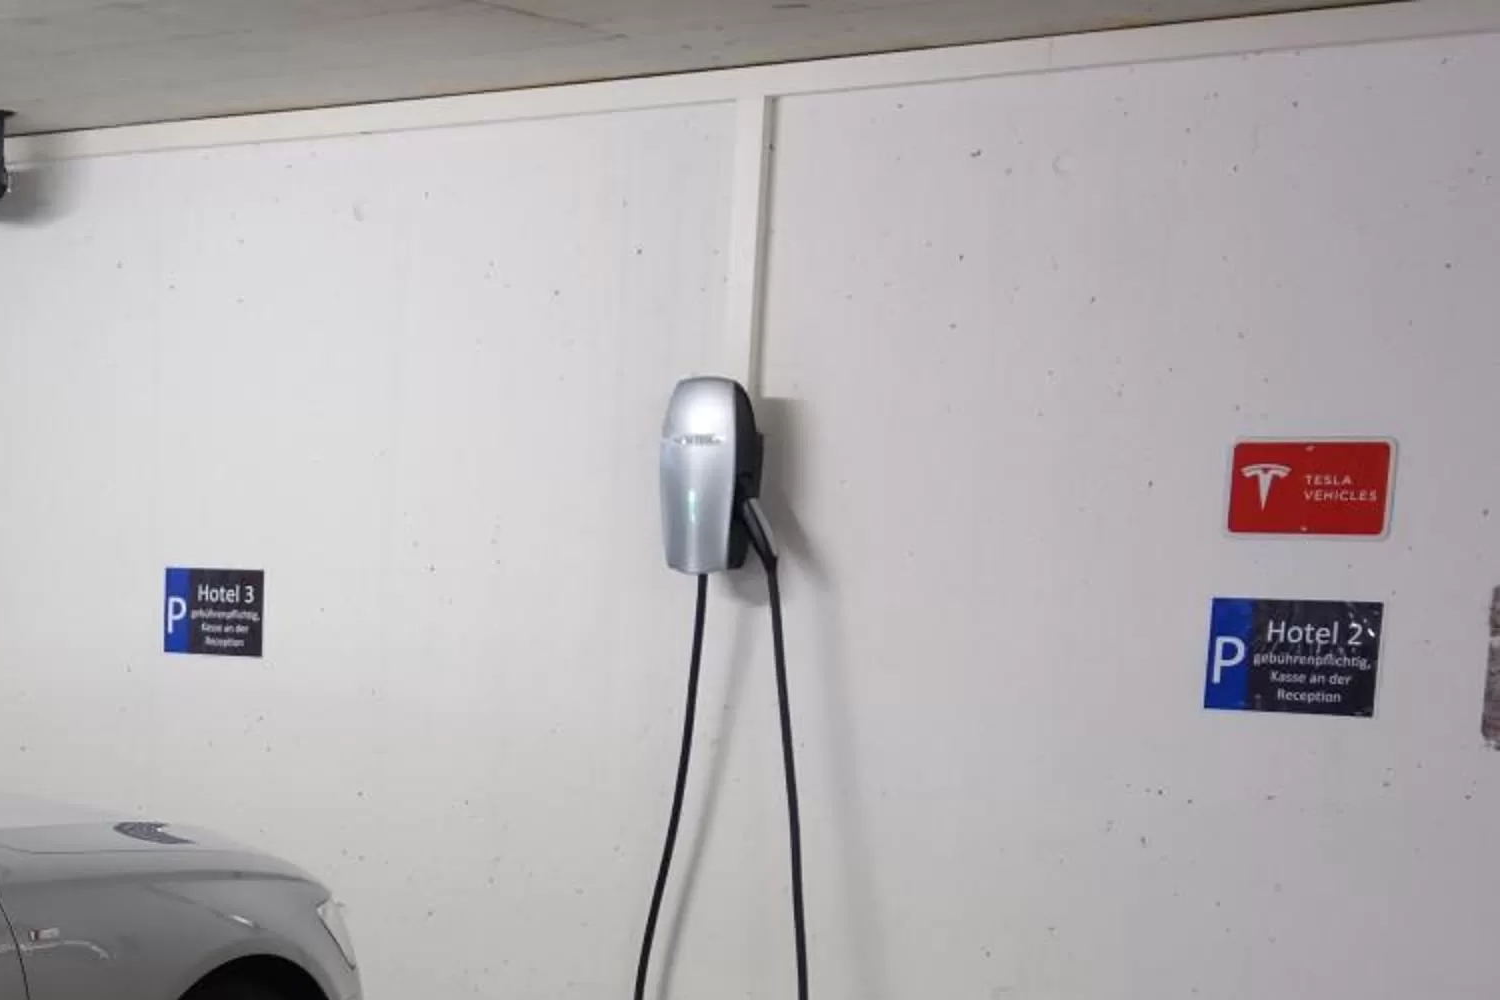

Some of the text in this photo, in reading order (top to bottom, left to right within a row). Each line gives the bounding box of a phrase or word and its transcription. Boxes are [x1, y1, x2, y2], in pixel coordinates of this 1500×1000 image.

[1303, 475, 1352, 486] TESLA
[1303, 489, 1378, 502] VEHICLES
[197, 583, 255, 604] Hotel 3
[167, 595, 187, 635] P
[1267, 619, 1364, 646] Hotel 2
[1211, 635, 1246, 684] P
[1270, 670, 1352, 685] Kasse an der
[1277, 688, 1342, 704] Reception
